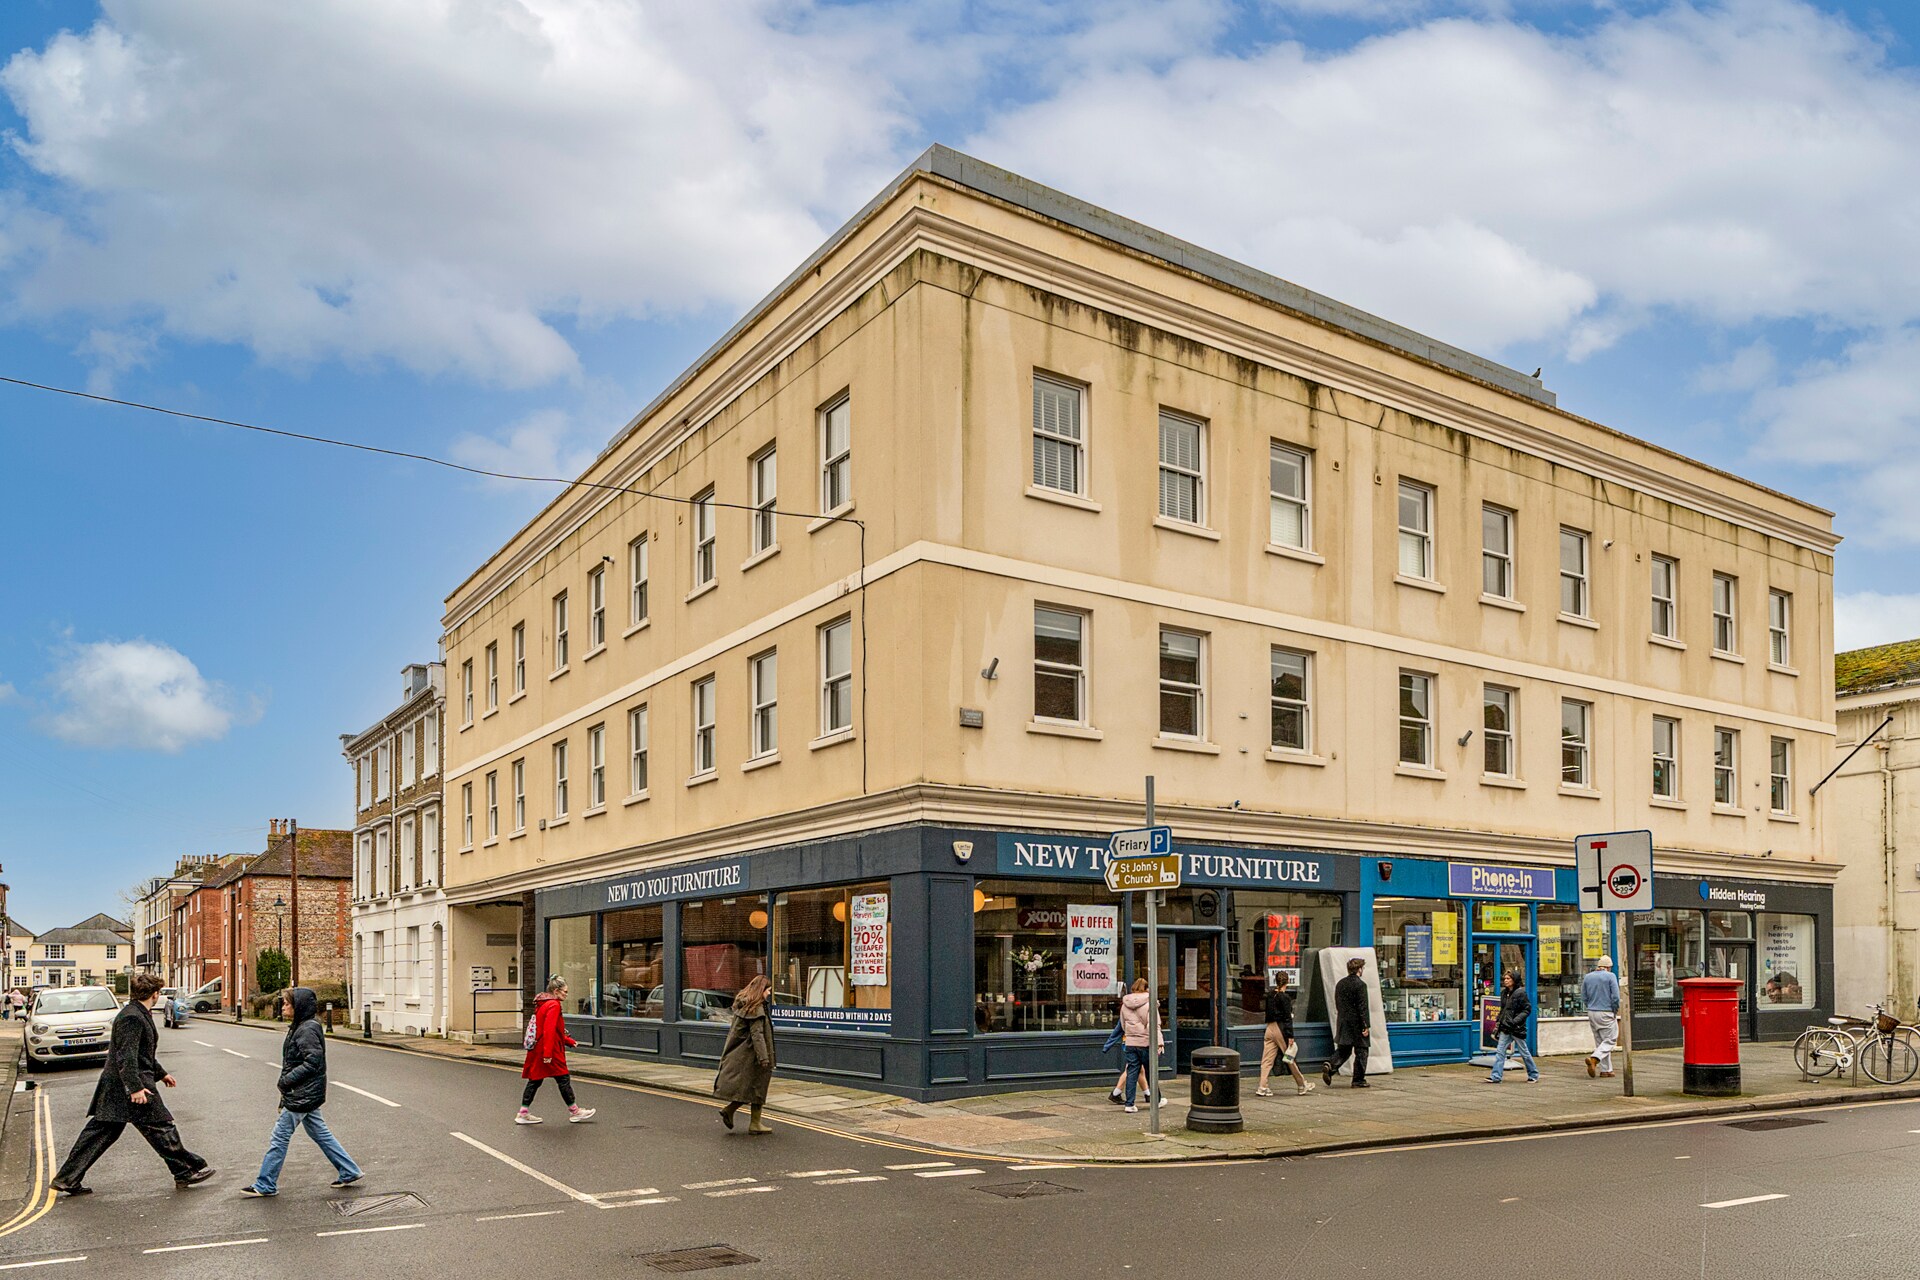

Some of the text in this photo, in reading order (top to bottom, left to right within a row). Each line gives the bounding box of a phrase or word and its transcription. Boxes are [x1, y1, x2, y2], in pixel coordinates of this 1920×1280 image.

[1119, 834, 1163, 852] Friary P
[1014, 842, 1079, 869] NEW
[1120, 863, 1130, 873] St
[1132, 861, 1158, 873] John's
[1189, 854, 1320, 883] FURNITURE
[608, 865, 740, 902] NEW TO YOU FURNITURE
[1124, 874, 1154, 885] Church
[1472, 867, 1532, 889] Phone-In
[1709, 887, 1766, 904] Hidden Hearing
[1740, 902, 1754, 910] Hearing
[1071, 916, 1114, 928] WE OFFER
[1268, 914, 1300, 928] UP TO
[854, 932, 884, 944] 70%
[1085, 937, 1111, 946] PayPal
[1268, 930, 1300, 952] 70%
[1084, 947, 1109, 955] CREDIT
[854, 966, 884, 974] ELSE
[1076, 970, 1108, 980] Klarna.
[782, 1009, 794, 1017] SOLD
[796, 1010, 812, 1018] ITEMS
[813, 1011, 844, 1020] DELIVERED
[846, 1012, 868, 1020] WITHIN
[874, 1013, 892, 1021] DAYS
